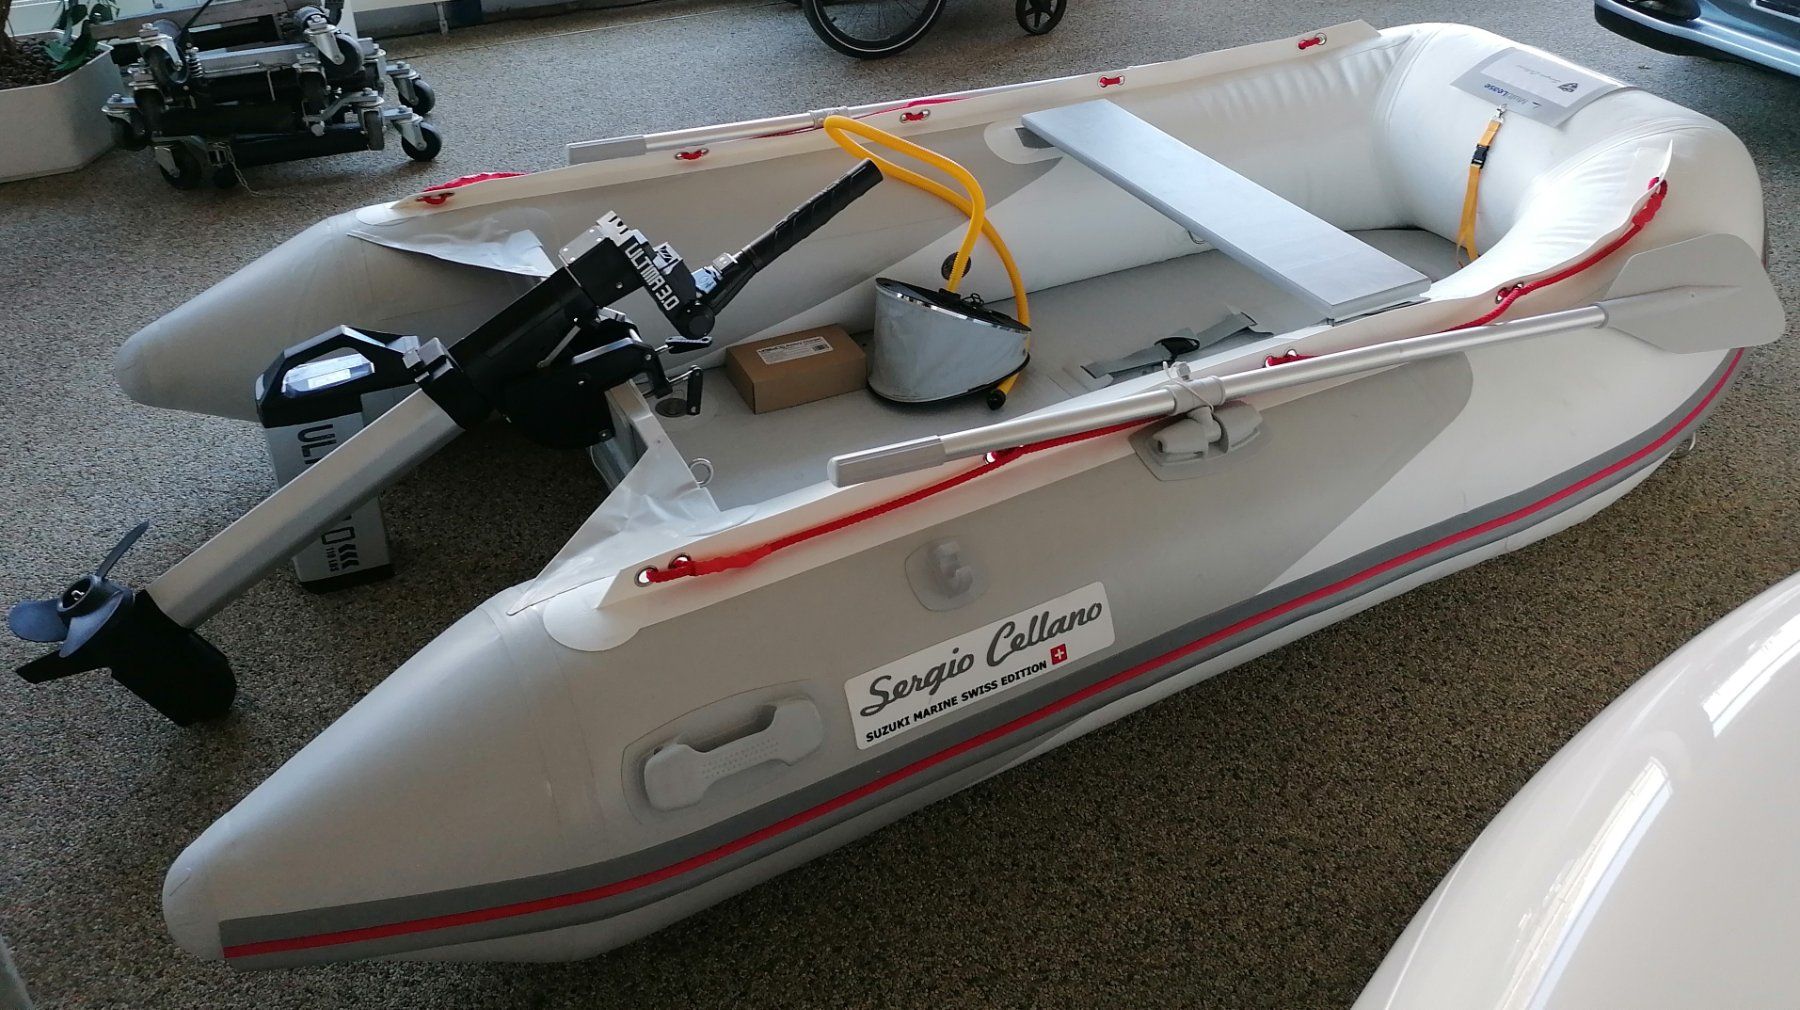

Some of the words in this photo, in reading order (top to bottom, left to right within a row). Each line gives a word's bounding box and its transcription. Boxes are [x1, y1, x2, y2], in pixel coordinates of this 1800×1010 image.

[860, 647, 974, 717] Sergio
[986, 602, 1102, 667] Cellano
[865, 716, 911, 743] SUZUKI
[913, 696, 959, 722] MARINE
[961, 680, 998, 702] SWISS
[1001, 660, 1047, 686] EDITION
